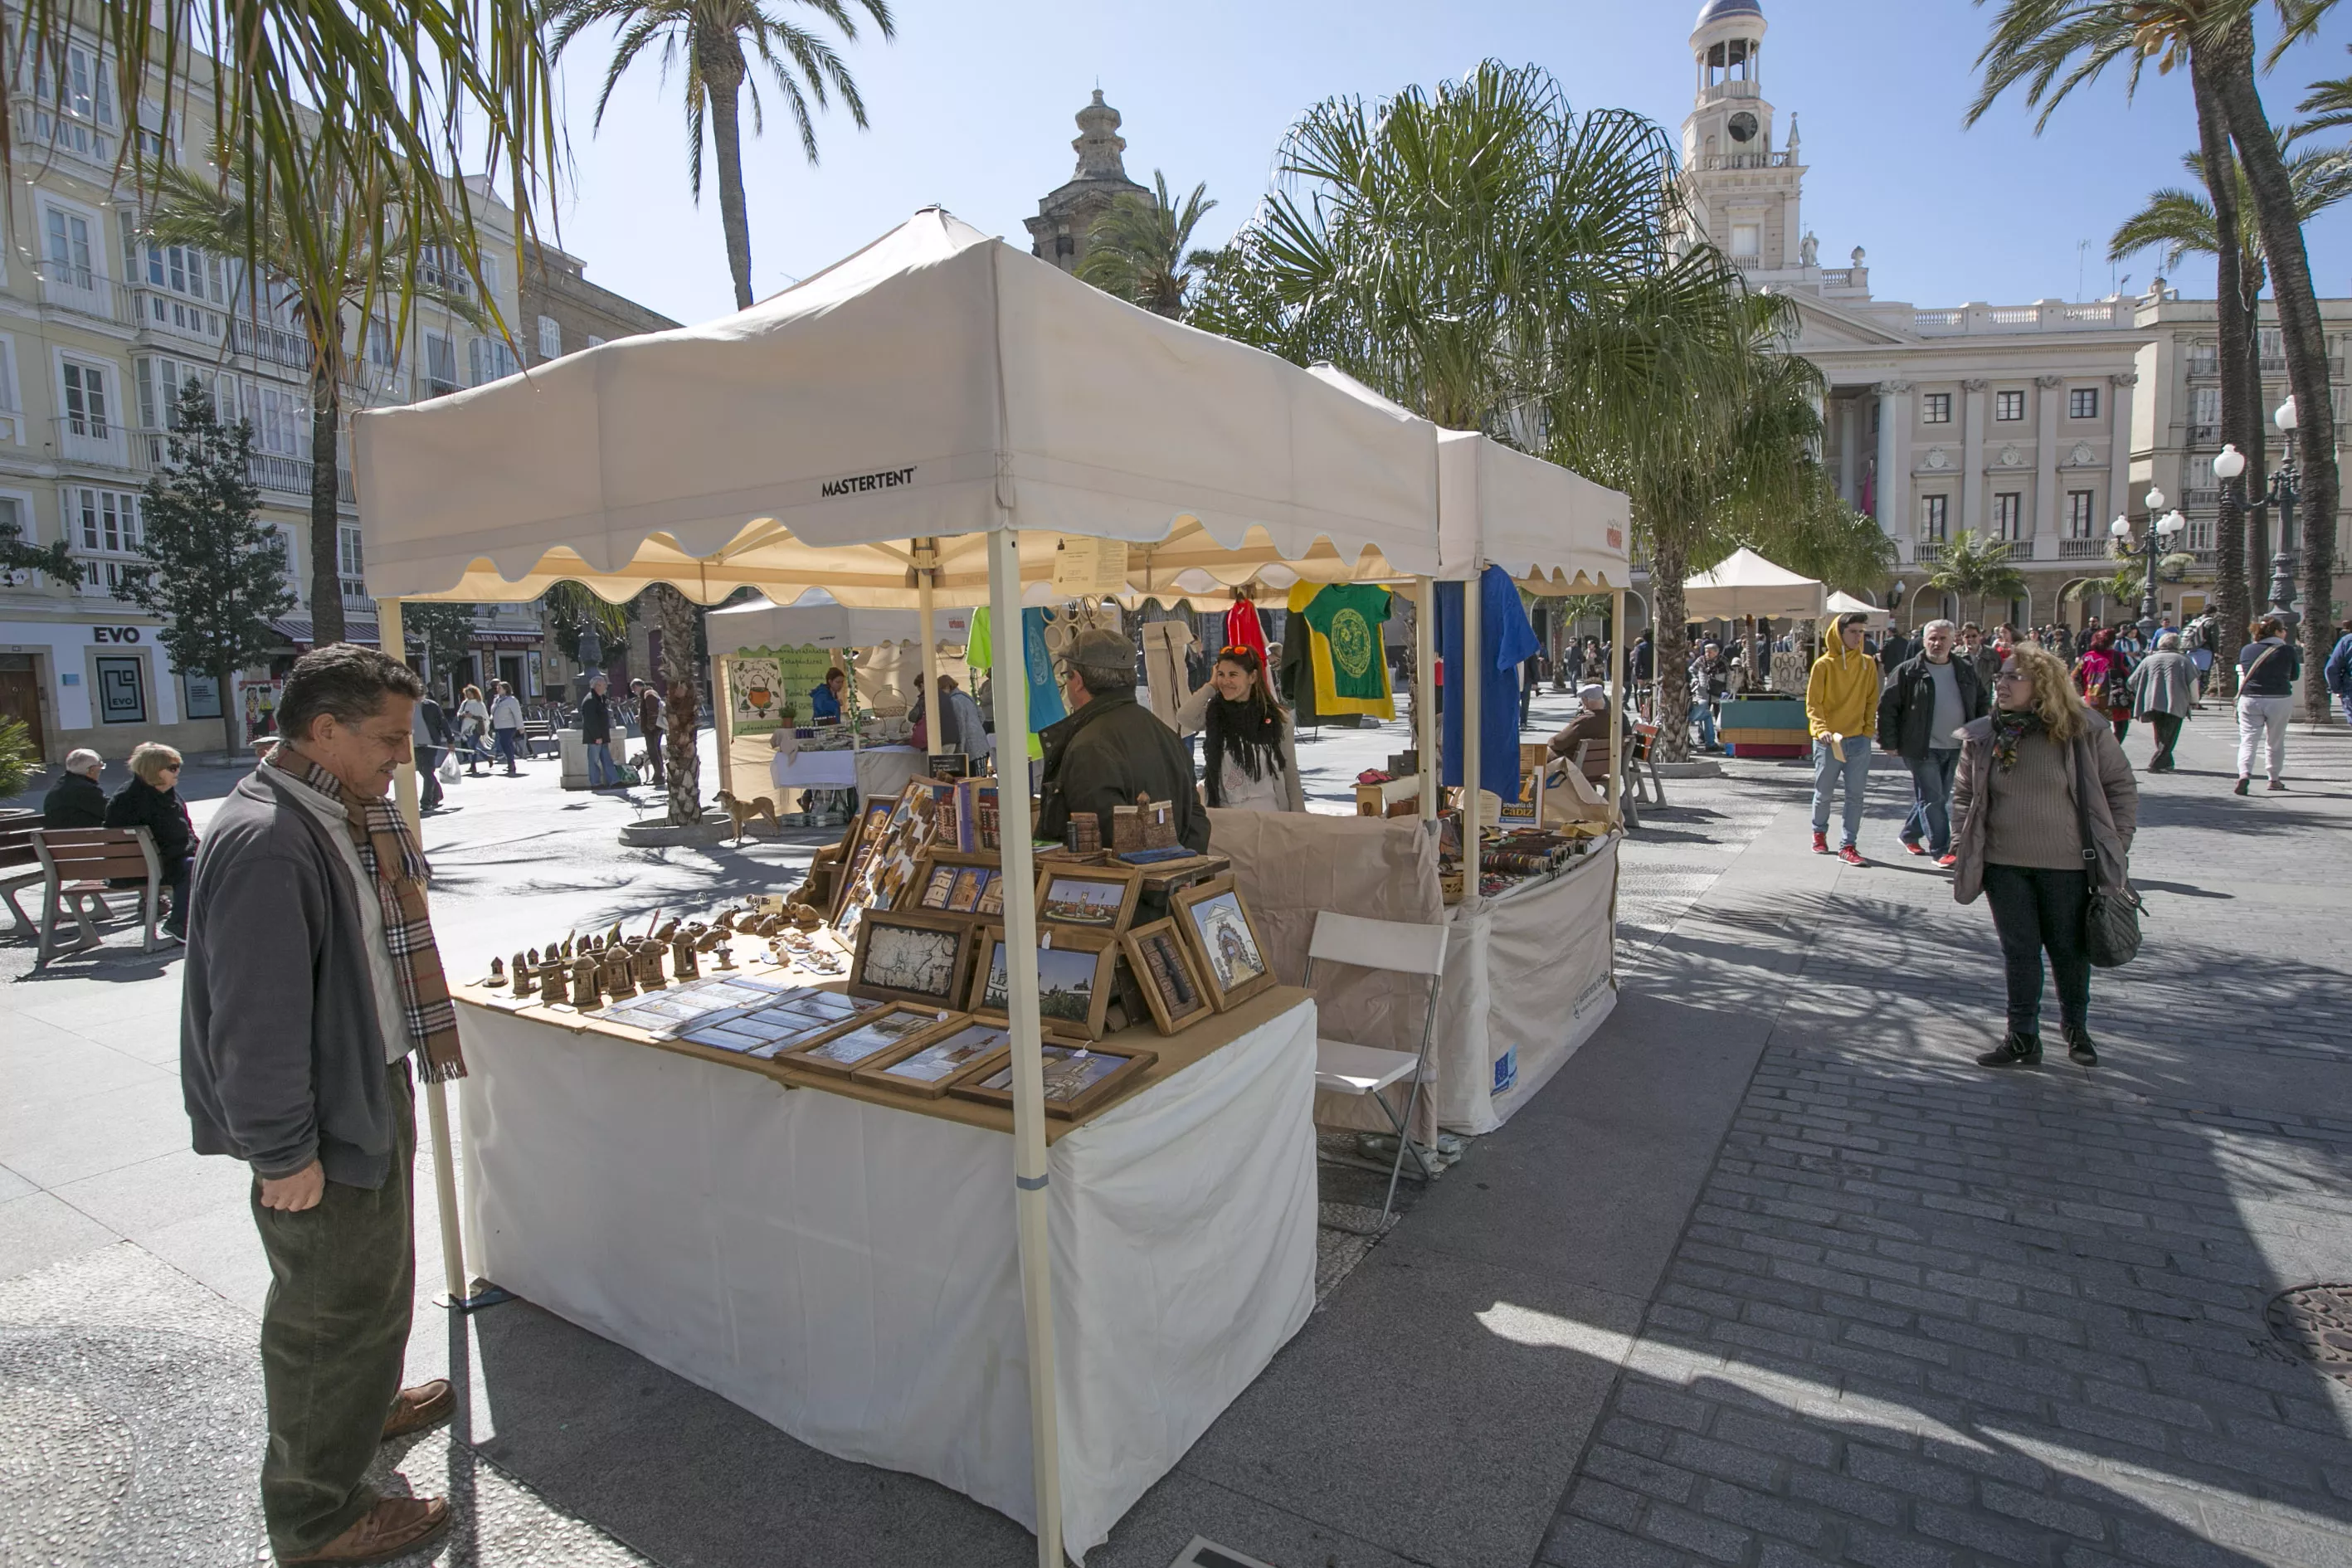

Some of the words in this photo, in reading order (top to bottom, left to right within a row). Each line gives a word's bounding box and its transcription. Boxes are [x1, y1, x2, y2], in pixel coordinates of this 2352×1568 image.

[822, 467, 914, 498] MASTERTENT
[93, 626, 140, 644] EVO
[112, 698, 133, 706] EVO
